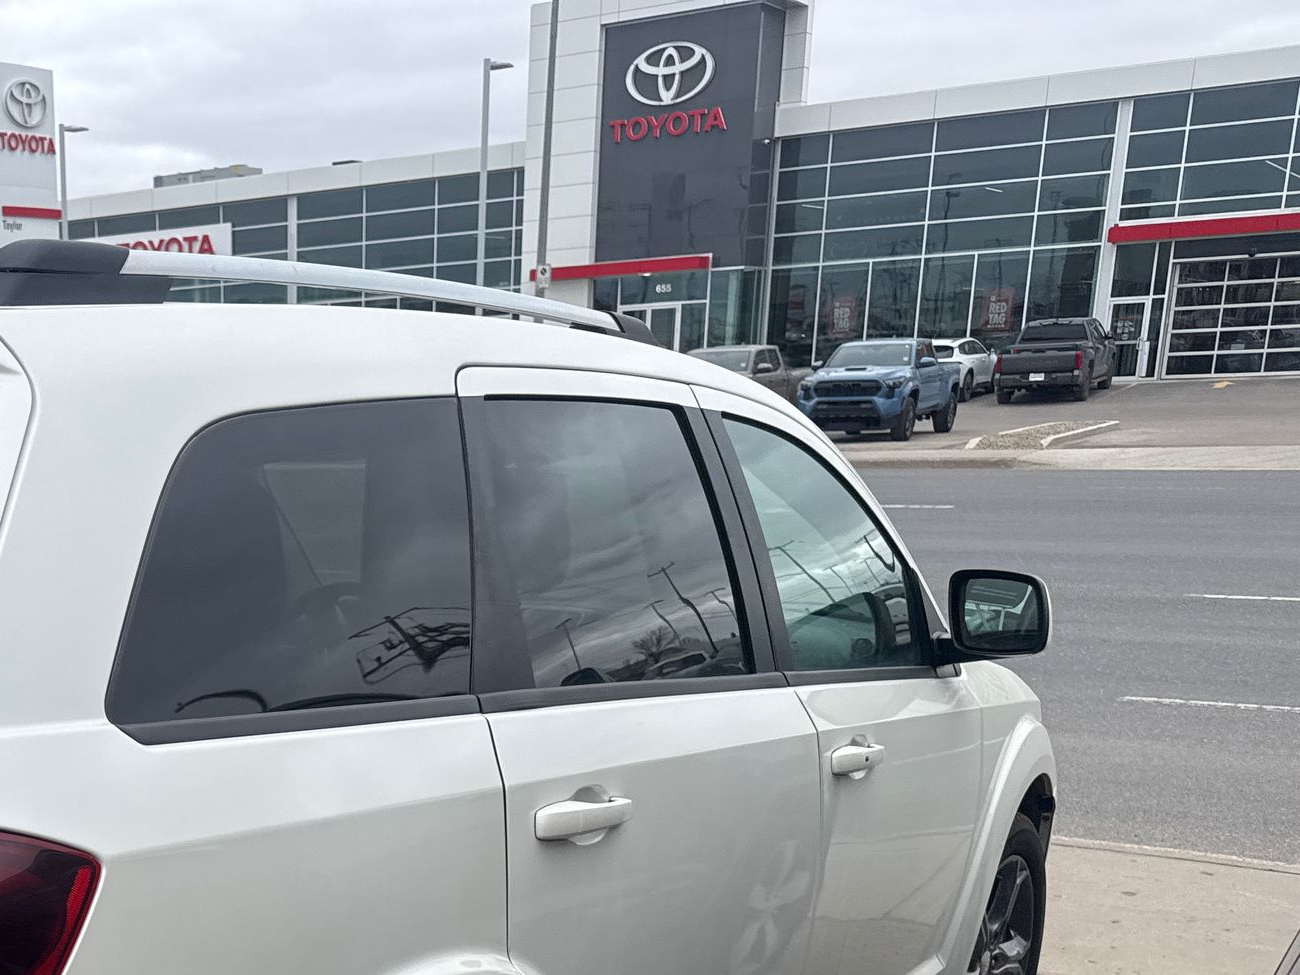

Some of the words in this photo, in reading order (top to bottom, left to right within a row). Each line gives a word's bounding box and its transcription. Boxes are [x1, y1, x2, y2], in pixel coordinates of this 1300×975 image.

[610, 106, 727, 143] TOYOTA
[116, 234, 215, 255] YOTA
[655, 283, 672, 294] 655
[833, 307, 851, 320] RED
[988, 302, 1007, 314] RED
[833, 318, 850, 330] TAG
[988, 311, 1006, 325] TAG
